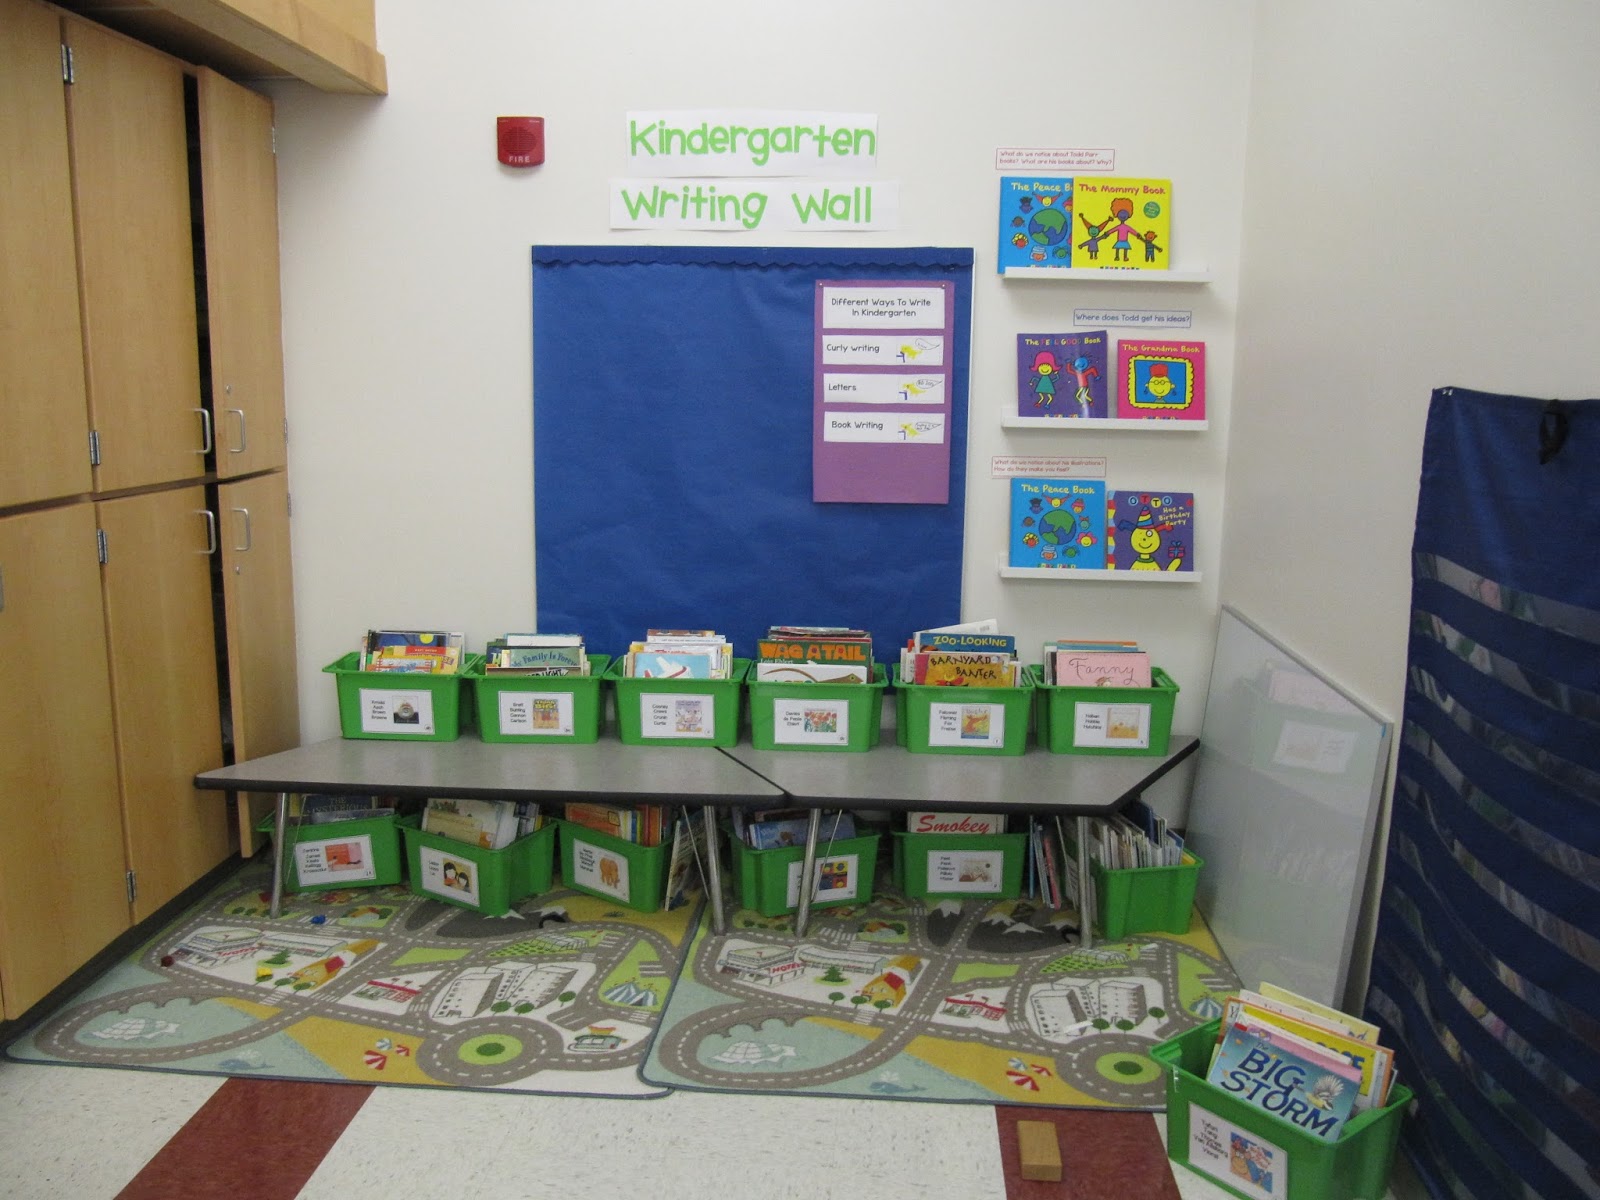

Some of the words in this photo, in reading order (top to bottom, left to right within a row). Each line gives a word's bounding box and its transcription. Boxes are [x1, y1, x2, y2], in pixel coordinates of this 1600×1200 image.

[630, 120, 875, 166] Kindergarten
[1011, 182, 1030, 191] The
[1033, 182, 1061, 191] Peace
[1079, 183, 1097, 192] The
[1101, 185, 1140, 196] Mommy
[1143, 185, 1166, 194] Book
[621, 185, 769, 230] Writing
[791, 186, 872, 224] Wall
[831, 298, 869, 307] Different
[872, 298, 895, 308] Ways
[897, 298, 908, 306] To
[909, 298, 931, 307] Write
[852, 308, 859, 316] In
[861, 308, 917, 319] Kindergarten
[1141, 315, 1153, 323] get
[1084, 336, 1102, 345] Book
[826, 344, 848, 353] Curly
[851, 344, 880, 353] writing
[1141, 344, 1178, 352] Grandma
[1181, 345, 1200, 353] Book
[828, 383, 857, 392] Letters
[831, 420, 851, 429] Book
[854, 421, 884, 431] Writing
[1021, 484, 1040, 492] The
[1042, 484, 1069, 493] Peace
[1073, 485, 1095, 494] Book
[1128, 494, 1173, 508] OTTO
[1159, 512, 1190, 521] Birthday
[933, 635, 1007, 647] ZOO-LOOKING
[522, 651, 548, 664] Family
[760, 642, 804, 659] WAG
[806, 644, 821, 660] A
[821, 644, 867, 662] TAIL
[930, 655, 992, 667] BARNYARD
[956, 666, 997, 680] BANTER
[1069, 657, 1137, 686] Fanny
[916, 814, 990, 835] Smokey
[1237, 1048, 1308, 1093] BIG
[1220, 1070, 1340, 1137] STORM
